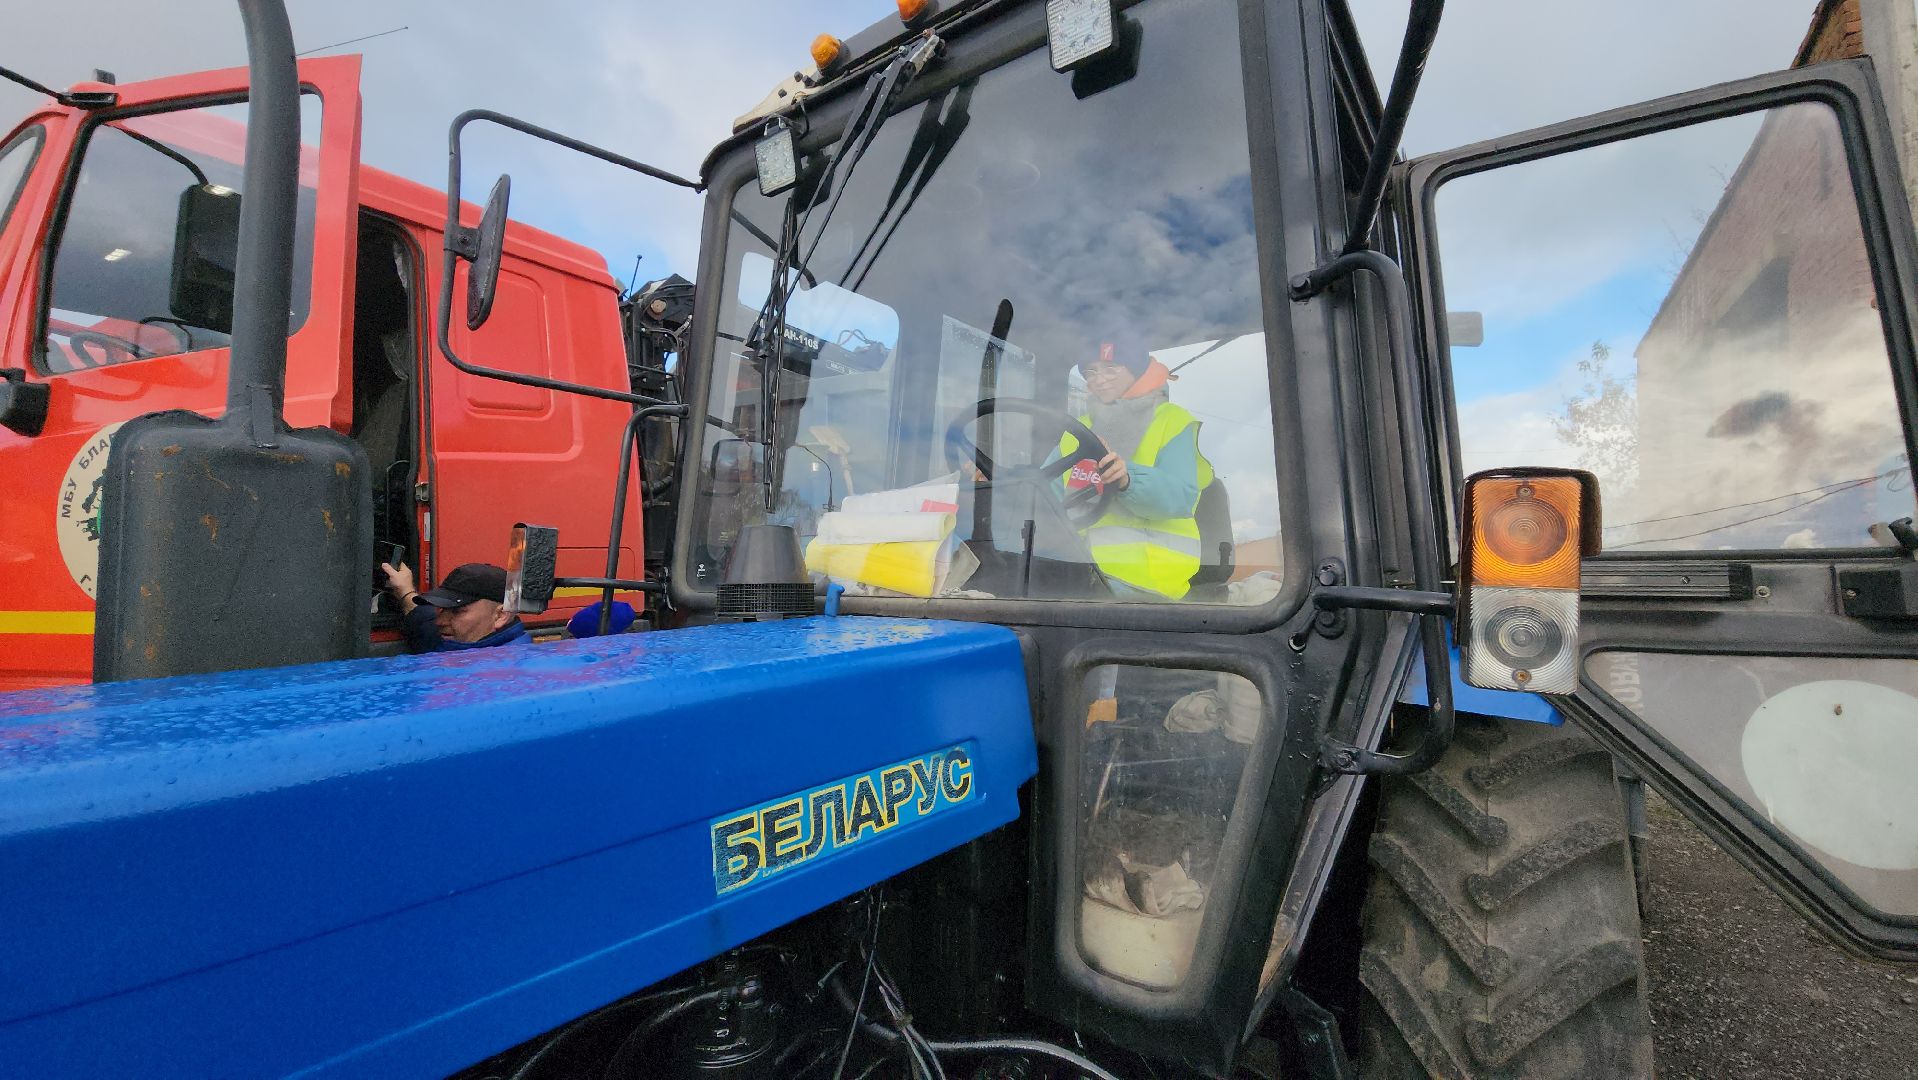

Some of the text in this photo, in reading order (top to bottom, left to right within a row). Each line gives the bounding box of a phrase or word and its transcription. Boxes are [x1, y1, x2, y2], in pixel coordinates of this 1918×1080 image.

[61, 438, 109, 518] МБУ БЛА
[711, 747, 972, 895] БЕЛАРУС
